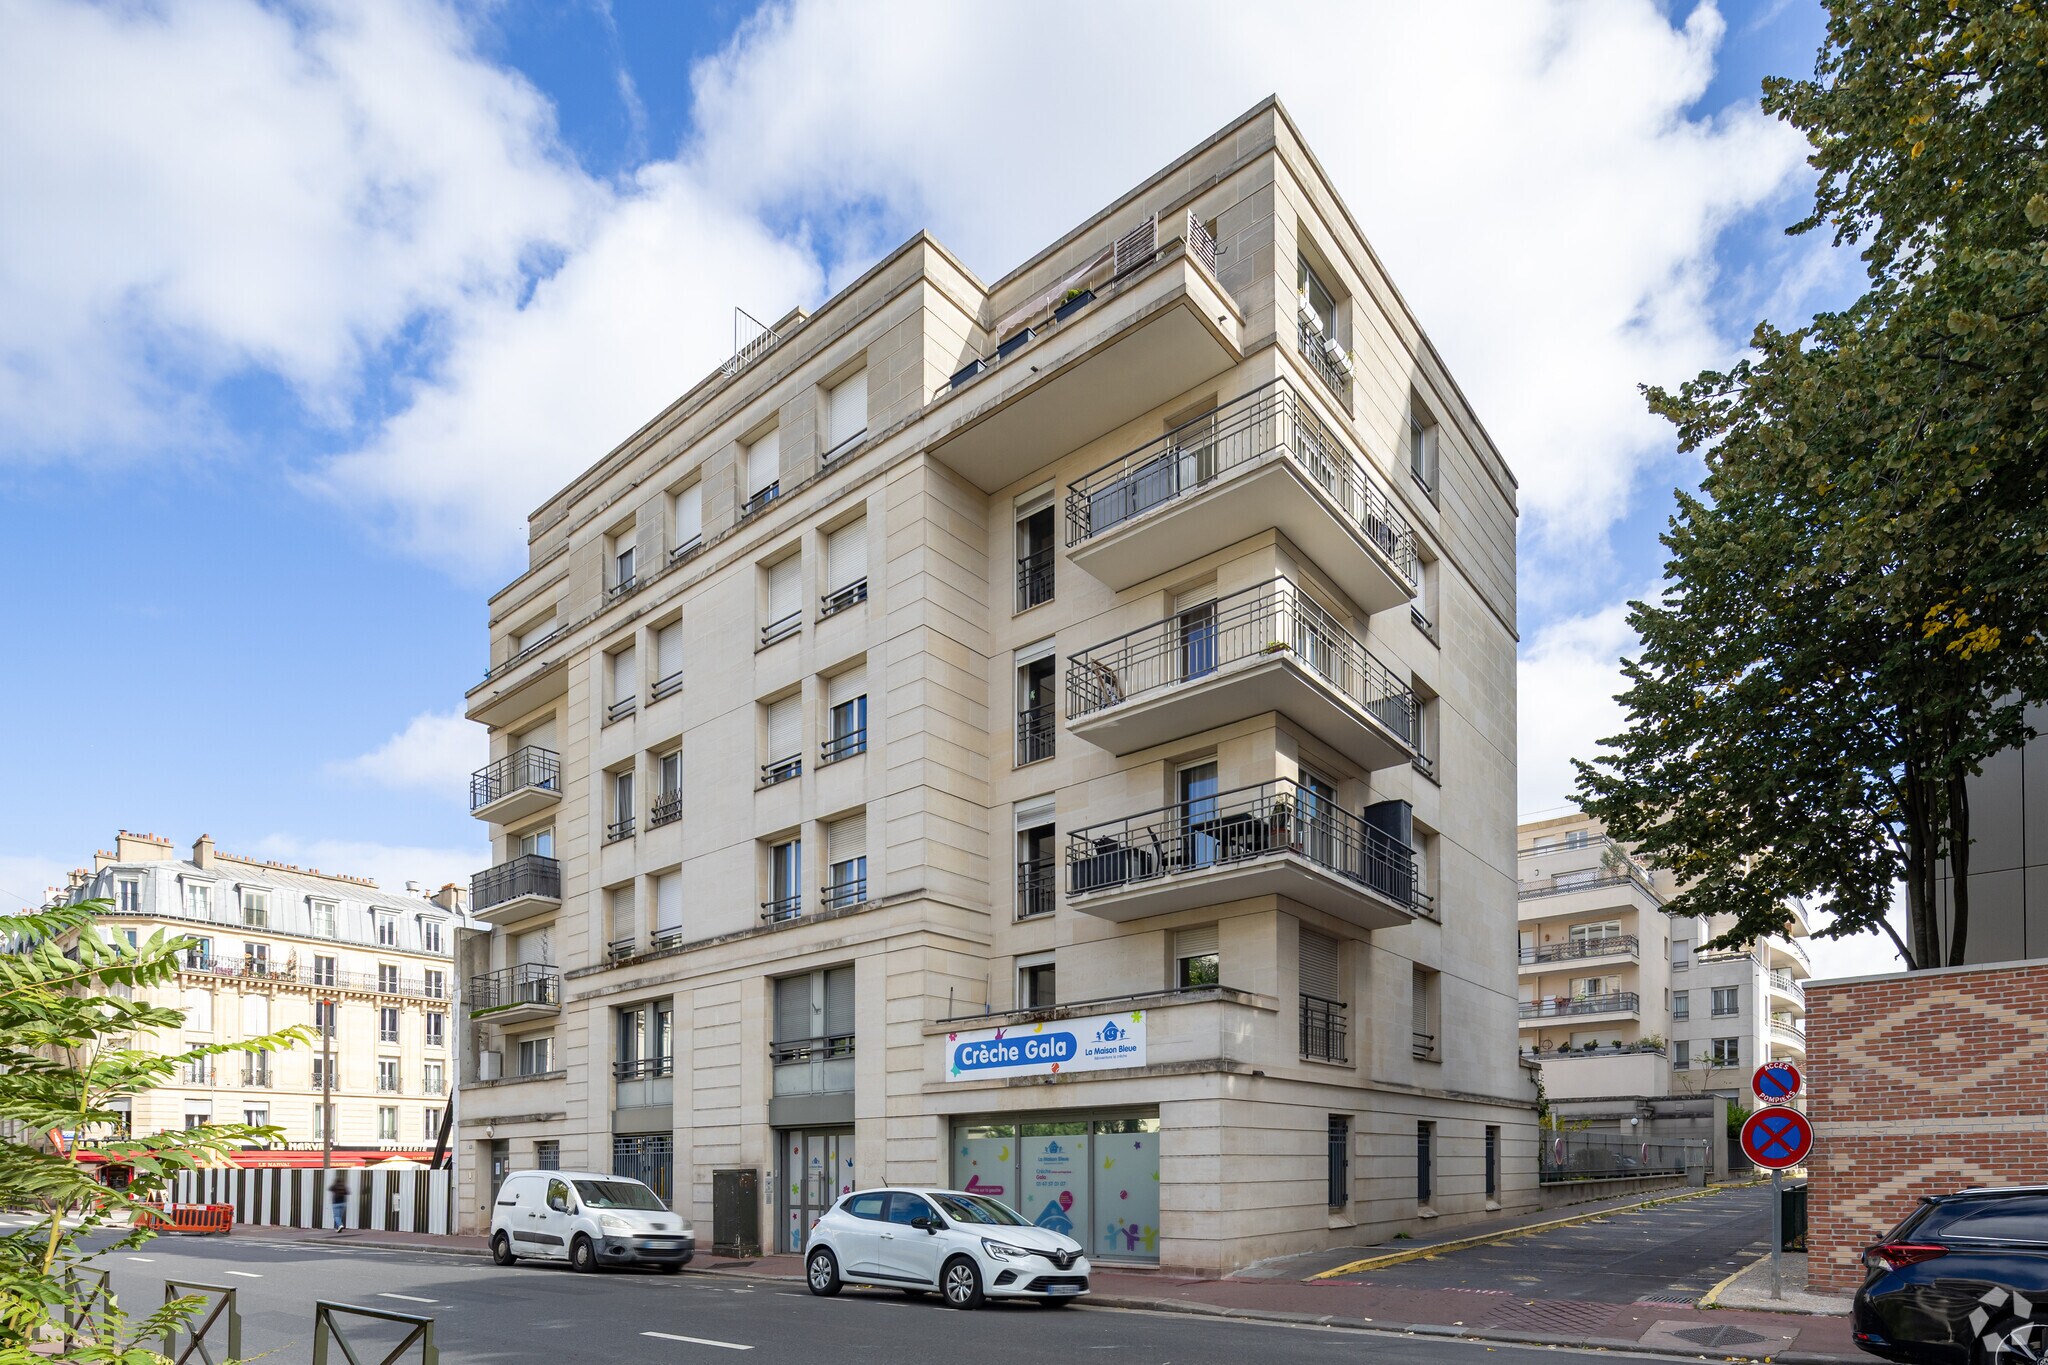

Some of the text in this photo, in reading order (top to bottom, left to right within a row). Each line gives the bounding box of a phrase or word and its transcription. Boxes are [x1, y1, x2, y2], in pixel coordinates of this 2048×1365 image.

[962, 1037, 1067, 1065] Crèche Gala
[1094, 1046, 1117, 1055] Maison
[1118, 1044, 1137, 1053] Bleue
[1764, 1062, 1790, 1071] ACCES
[1759, 1090, 1796, 1103] POMPIERS
[270, 1142, 285, 1151] LE
